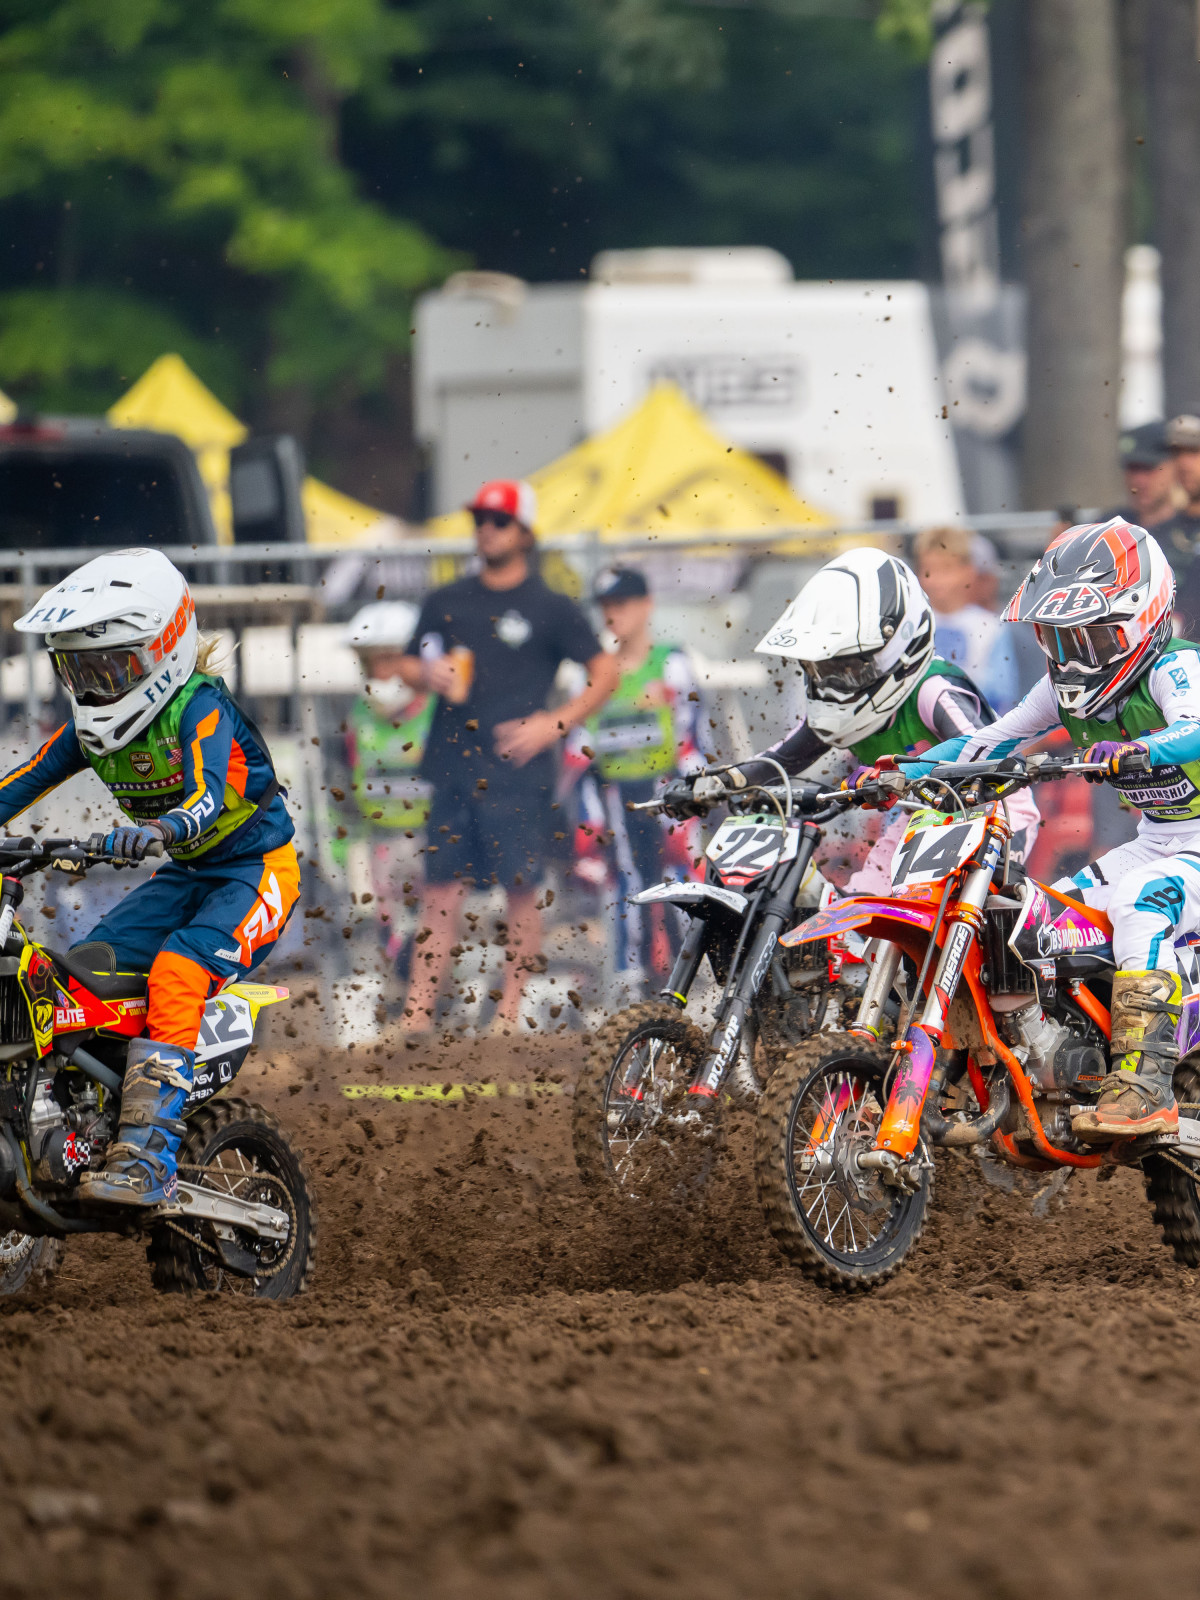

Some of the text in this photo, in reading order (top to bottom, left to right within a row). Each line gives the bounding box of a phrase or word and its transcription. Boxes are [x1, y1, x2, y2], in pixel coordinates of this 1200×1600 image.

[27, 607, 77, 624] FLY
[148, 587, 196, 664] 100%
[143, 669, 172, 704] FLY
[1124, 782, 1189, 802] AMPIONSHIP
[713, 827, 784, 870] 22
[892, 823, 974, 887] 14
[52, 857, 82, 872] ASV
[1062, 930, 1084, 948] MOTO
[1085, 926, 1107, 946] LAB
[56, 1009, 86, 1025] ELITE
